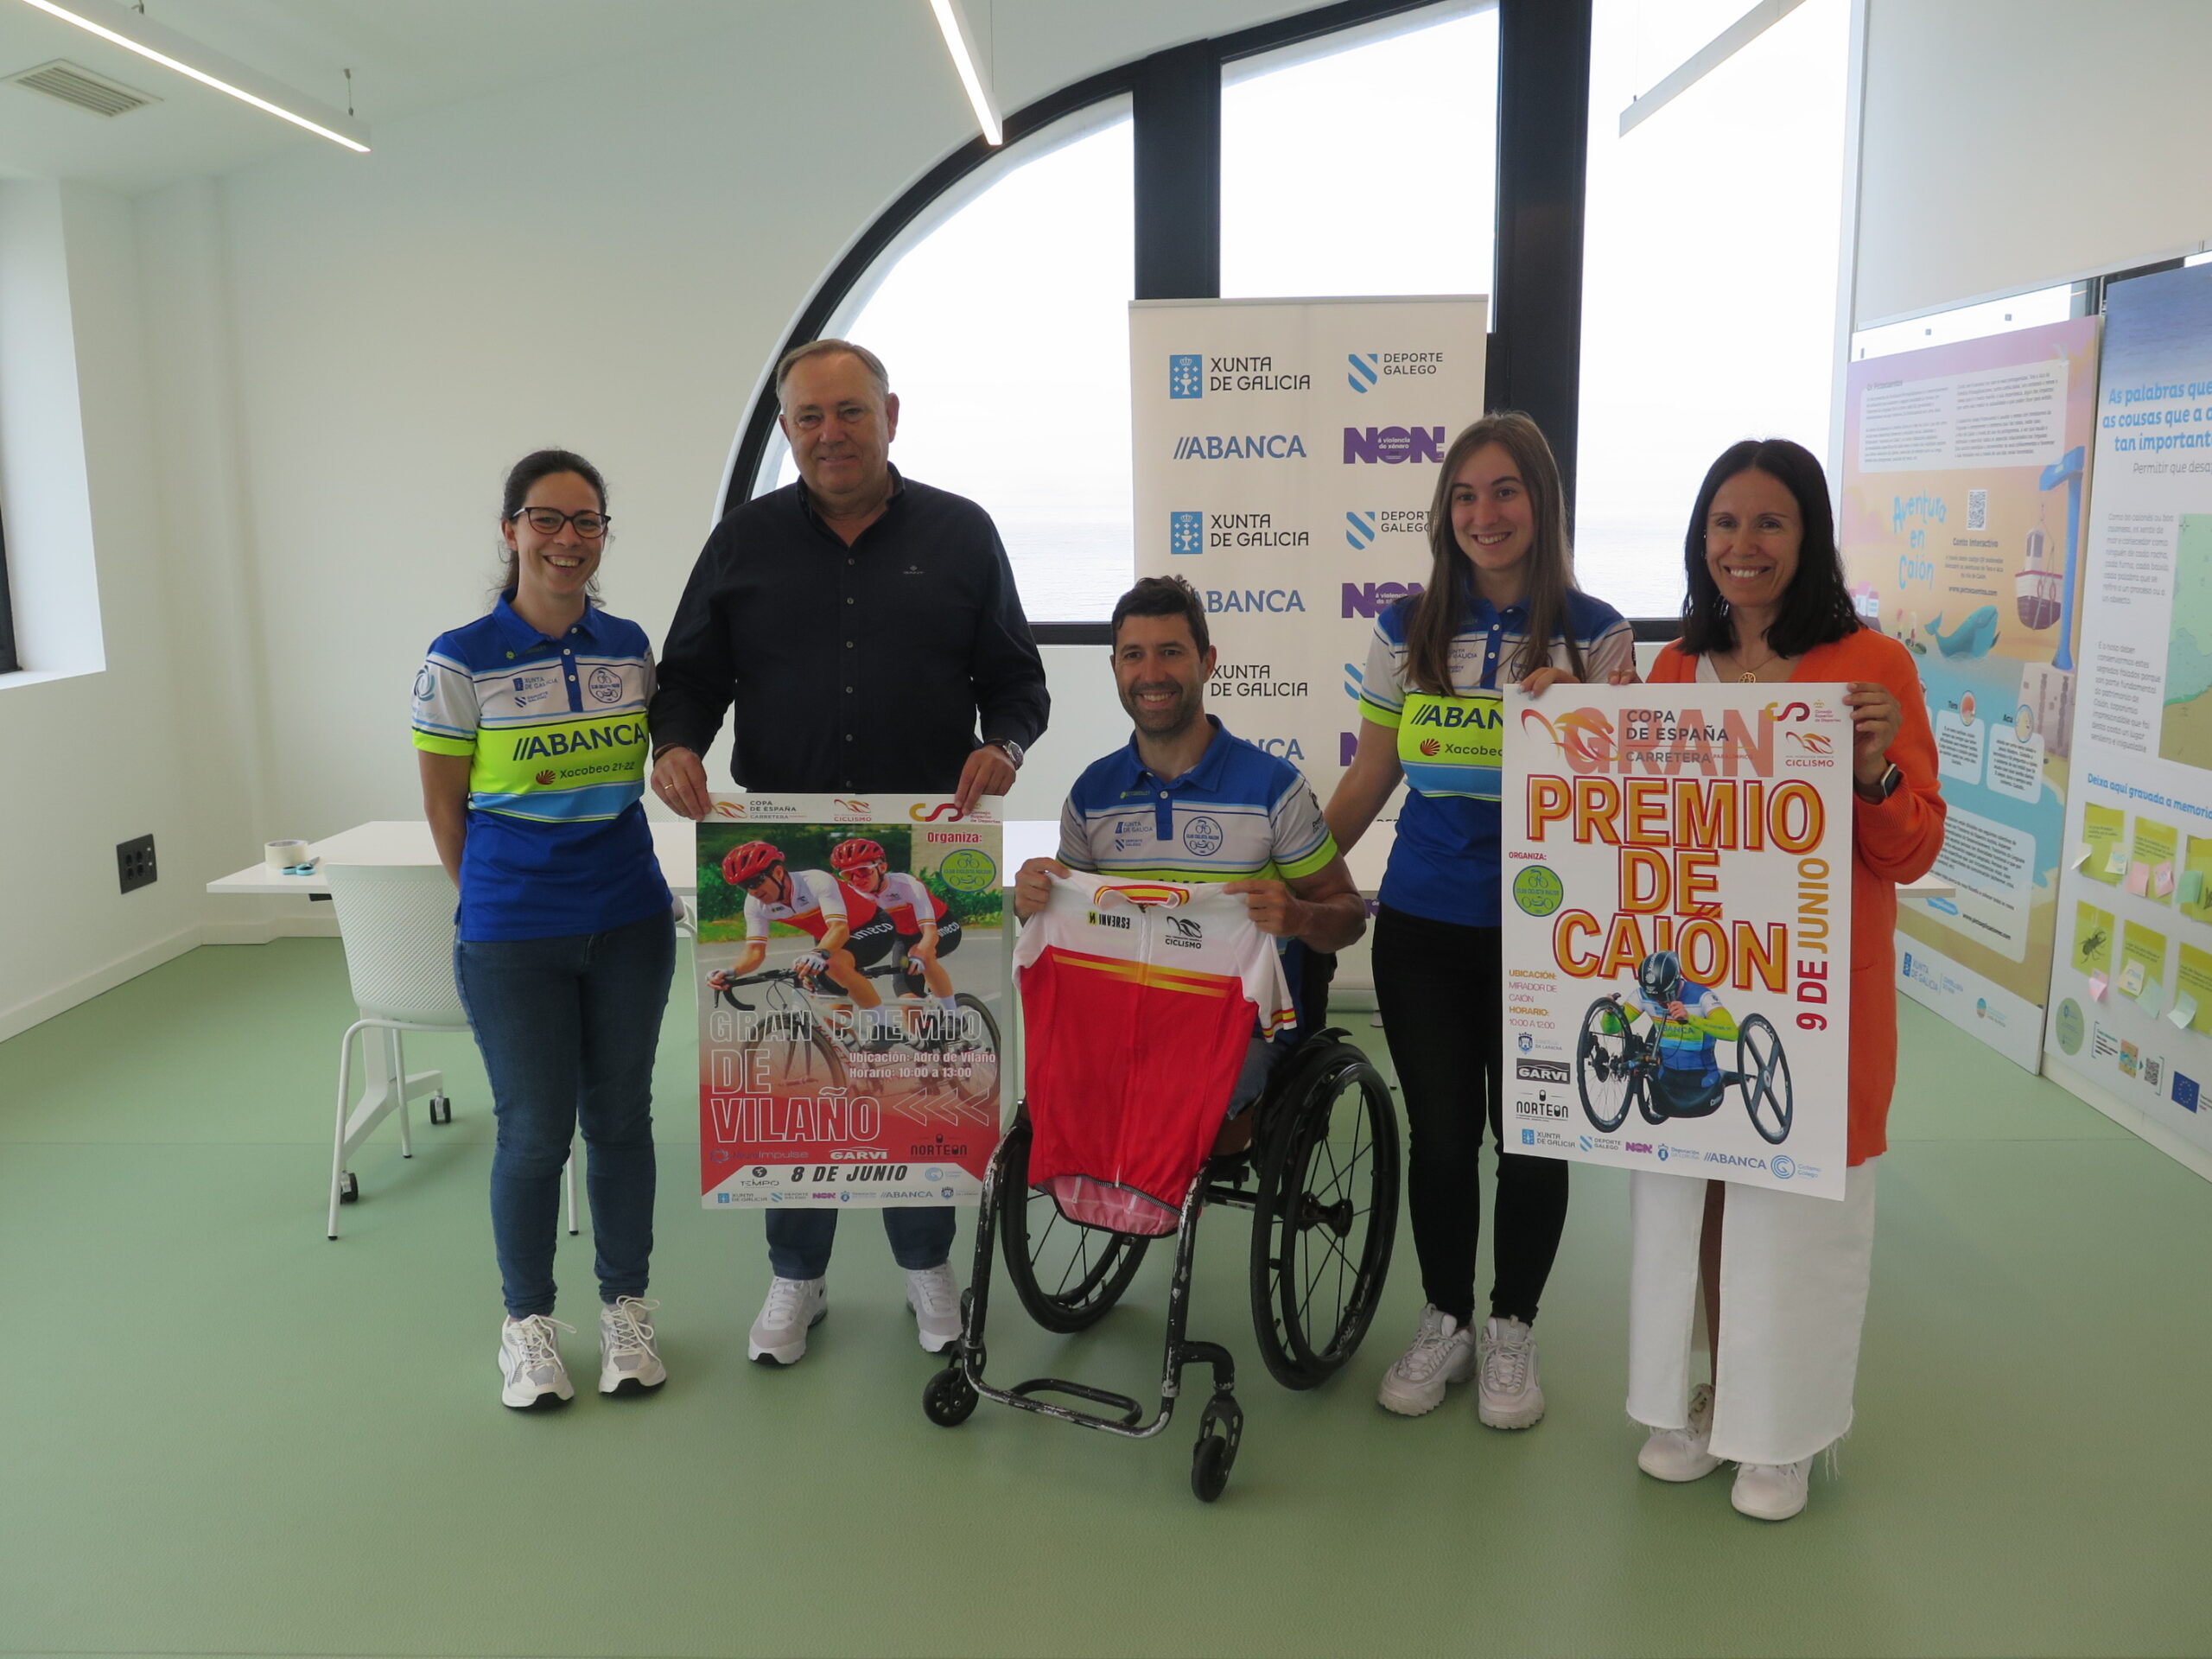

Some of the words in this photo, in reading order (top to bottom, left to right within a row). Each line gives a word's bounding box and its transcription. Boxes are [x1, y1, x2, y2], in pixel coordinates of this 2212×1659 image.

[1211, 357, 1271, 372] XUNTA
[1384, 353, 1443, 364] DEPORTE
[1383, 365, 1437, 375] GALEGO
[1211, 377, 1231, 391] DE
[1237, 375, 1310, 391] GALICIA
[2108, 389, 2122, 404] As
[2126, 385, 2184, 407] palabras
[2103, 415, 2116, 429] as
[2119, 411, 2162, 428] cousas
[2165, 409, 2190, 428] que
[2194, 408, 2202, 422] a
[2115, 436, 2136, 451] tan
[2133, 461, 2169, 474] Permitir
[2171, 463, 2187, 475] que
[1211, 514, 1271, 529] XUNTA
[1211, 534, 1231, 547] DE
[1237, 532, 1309, 546] GALICIA
[1910, 529, 1926, 549] en
[1211, 665, 1270, 679] XUNTA
[1211, 683, 1232, 696] DE
[1237, 682, 1308, 696] GALICIA
[1627, 709, 1676, 723] COPA
[1626, 728, 1649, 741] DE
[1656, 725, 1730, 741] ESPAÑA
[1625, 751, 1712, 764] CARRETERA
[1785, 759, 1834, 767] CICLISMO
[560, 764, 610, 779] Xacobeo
[612, 761, 635, 772] 21-22
[2088, 772, 2108, 789] Deixa
[2129, 786, 2164, 805] gravada
[2166, 798, 2172, 807] a
[1527, 773, 1827, 855] PREMIO
[927, 831, 982, 843] Organiza:
[1509, 851, 1548, 861] ORGANIZA:
[1618, 845, 1721, 917] DE
[1797, 857, 1830, 955] JUNIO
[1166, 938, 1202, 950] CICLISMO
[1553, 903, 1789, 995] CAIÓN
[1509, 981, 1546, 992] MIRADOR
[1547, 984, 1558, 993] DE
[1797, 959, 1828, 1005] DE
[709, 1009, 812, 1042] GRAN
[832, 1008, 982, 1041] PREMIO
[1796, 1011, 1827, 1032] 9
[849, 1051, 911, 1064] Ubicación:
[913, 1052, 940, 1063] Adro
[943, 1052, 957, 1063] de
[960, 1051, 996, 1064] Vilaño
[711, 1048, 772, 1095] DE
[849, 1067, 895, 1078] Horario:
[899, 1067, 929, 1078] 10:00
[932, 1070, 939, 1078] a
[943, 1066, 972, 1078] 13:00
[1518, 1067, 1568, 1082] GARVI
[710, 1085, 880, 1144] VILAÑO
[1536, 1131, 1561, 1140] XUNTA
[1547, 1139, 1576, 1148] GALICIA
[830, 1151, 887, 1160] GARVI
[791, 1166, 805, 1183] 8
[812, 1166, 839, 1183] DE
[846, 1165, 908, 1182] JUNIO
